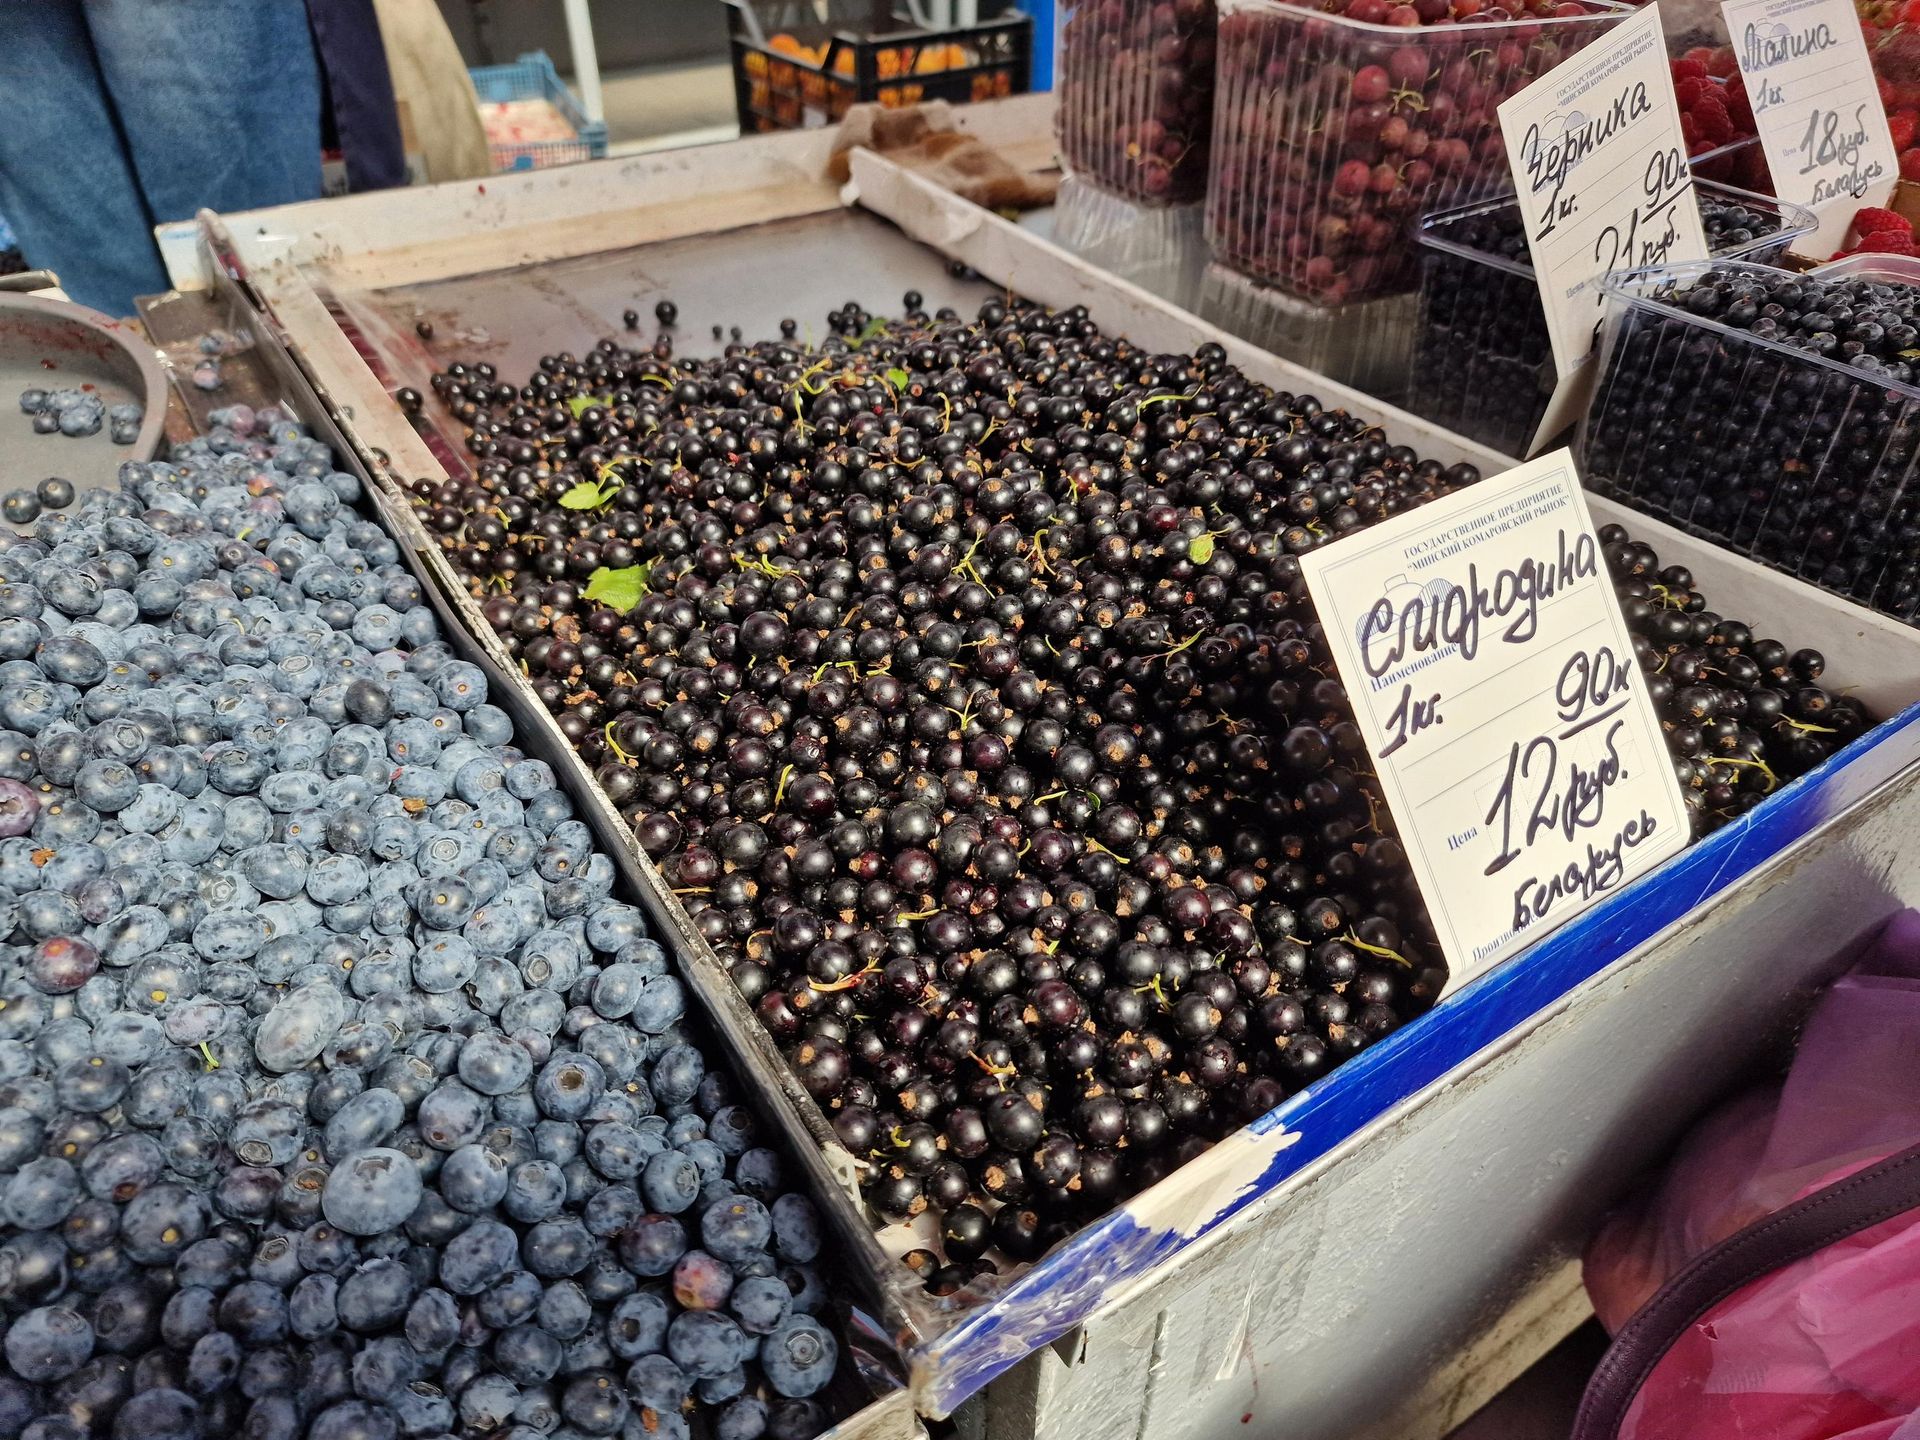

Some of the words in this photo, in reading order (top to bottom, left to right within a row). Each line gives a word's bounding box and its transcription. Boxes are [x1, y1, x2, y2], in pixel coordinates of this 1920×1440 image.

[1556, 56, 1612, 99] ГОСУДАРСТВЕННОЕ
[1611, 30, 1653, 63] ПРЕДПРИЯТИЕ
[1590, 54, 1634, 88] КОМАРОВСКИЙ
[1741, 22, 1837, 73] Малина
[1520, 81, 1652, 191] Черника
[1566, 281, 1585, 299] Цена
[1403, 511, 1498, 560] ГОСУДАРСТВЕННОЕ
[1498, 483, 1564, 519] ПРЕДПРИЯТИЕ
[1461, 510, 1536, 549] КОМАРОВСКИЙ
[1361, 528, 1598, 679] Смородина
[1370, 641, 1460, 693] Наименование
[1447, 825, 1478, 851] Цена
[1512, 808, 1658, 932] Беларусь
